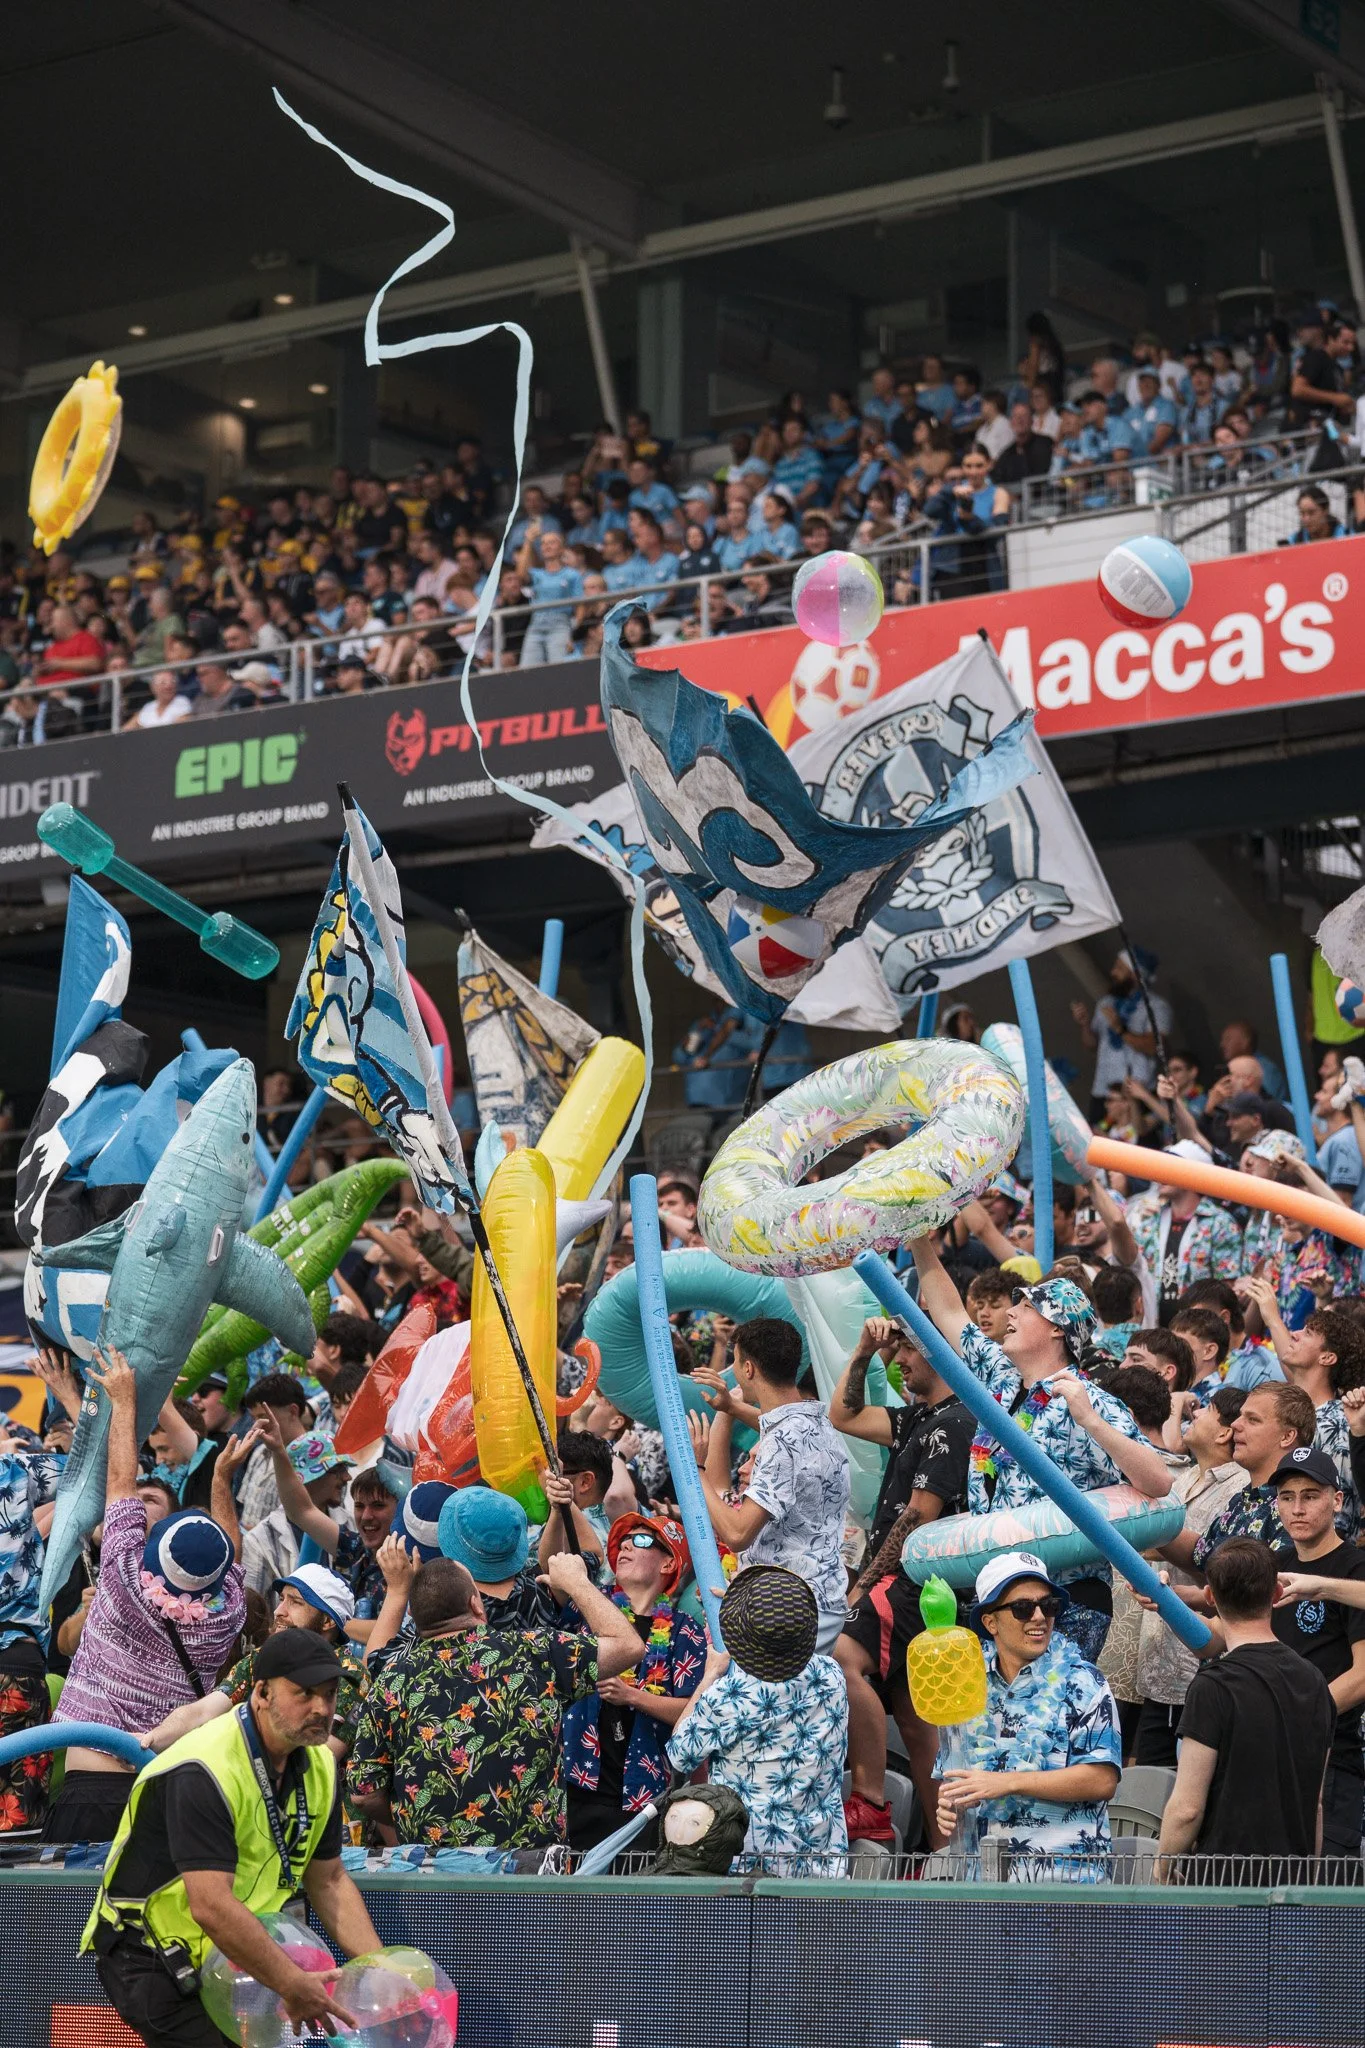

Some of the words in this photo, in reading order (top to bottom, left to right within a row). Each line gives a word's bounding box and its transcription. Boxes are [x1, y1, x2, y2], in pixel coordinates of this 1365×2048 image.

[428, 703, 608, 756] PITBULL
[175, 733, 298, 799] EPIC
[403, 788, 425, 807] AN
[426, 780, 494, 802] INDUSTREE
[546, 764, 594, 787] BRAND
[151, 823, 172, 842] AN
[173, 814, 236, 838] INDUSTREE
[236, 807, 283, 830] GROUP
[284, 801, 329, 824] BRAND
[266, 1800, 290, 1869] ELECTRONICS
